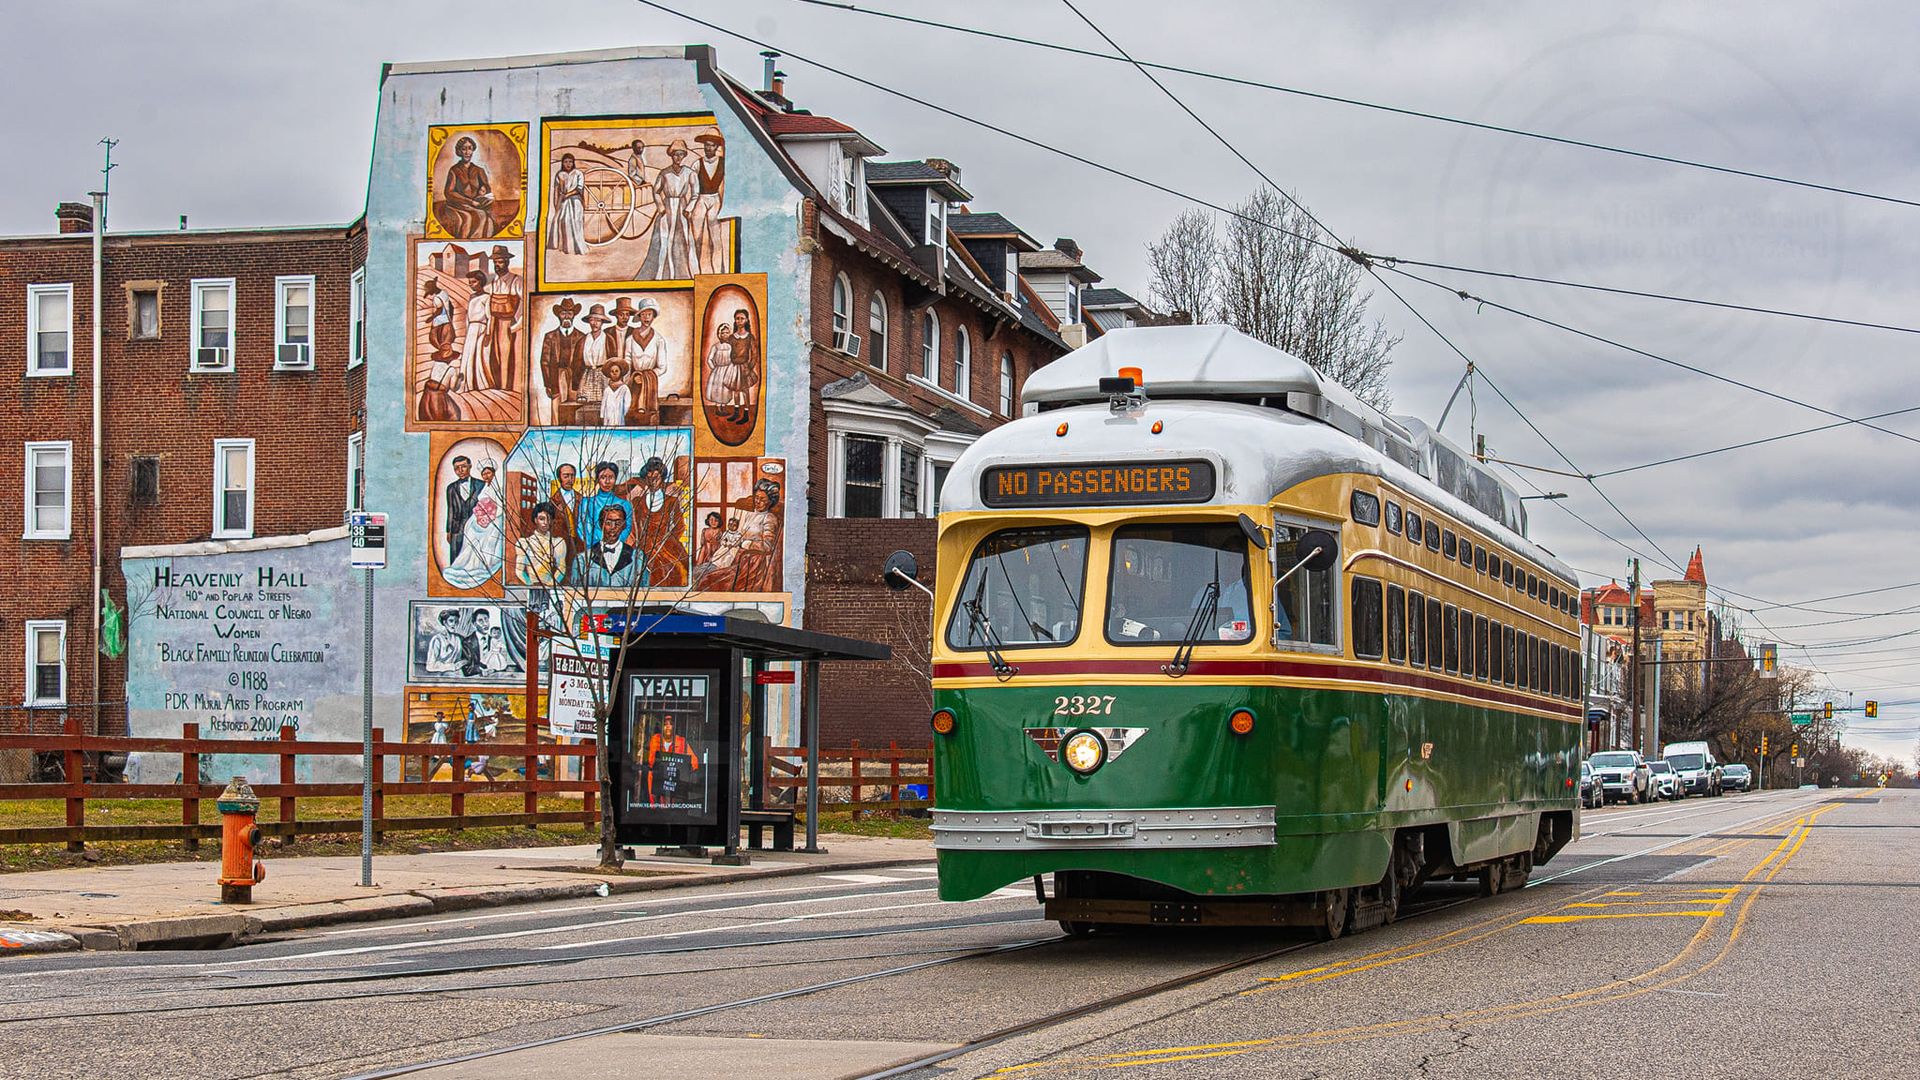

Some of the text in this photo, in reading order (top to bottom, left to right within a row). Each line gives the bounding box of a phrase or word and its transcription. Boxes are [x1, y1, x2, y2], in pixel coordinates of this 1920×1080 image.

[999, 467, 1191, 495] NO PASSENGERS
[353, 526, 365, 536] 38
[353, 537, 365, 547] 40
[155, 567, 308, 587] HEAVENLY HALL
[205, 593, 220, 601] AND
[222, 589, 254, 601] POPLAR
[258, 589, 292, 601] STREETS
[156, 604, 312, 619] NATIONAL COUNCIL OF NEGRO
[213, 623, 261, 638] WOMEN
[197, 643, 231, 662] FAMILY
[233, 643, 270, 662] REUNION
[591, 662, 609, 677] CAE
[638, 679, 693, 697] YEAH
[165, 693, 303, 711] PDR MURAL ARTS PROGRAM
[558, 697, 585, 708] MONDAY
[1054, 695, 1118, 715] 2327
[210, 715, 249, 731] RESTORED
